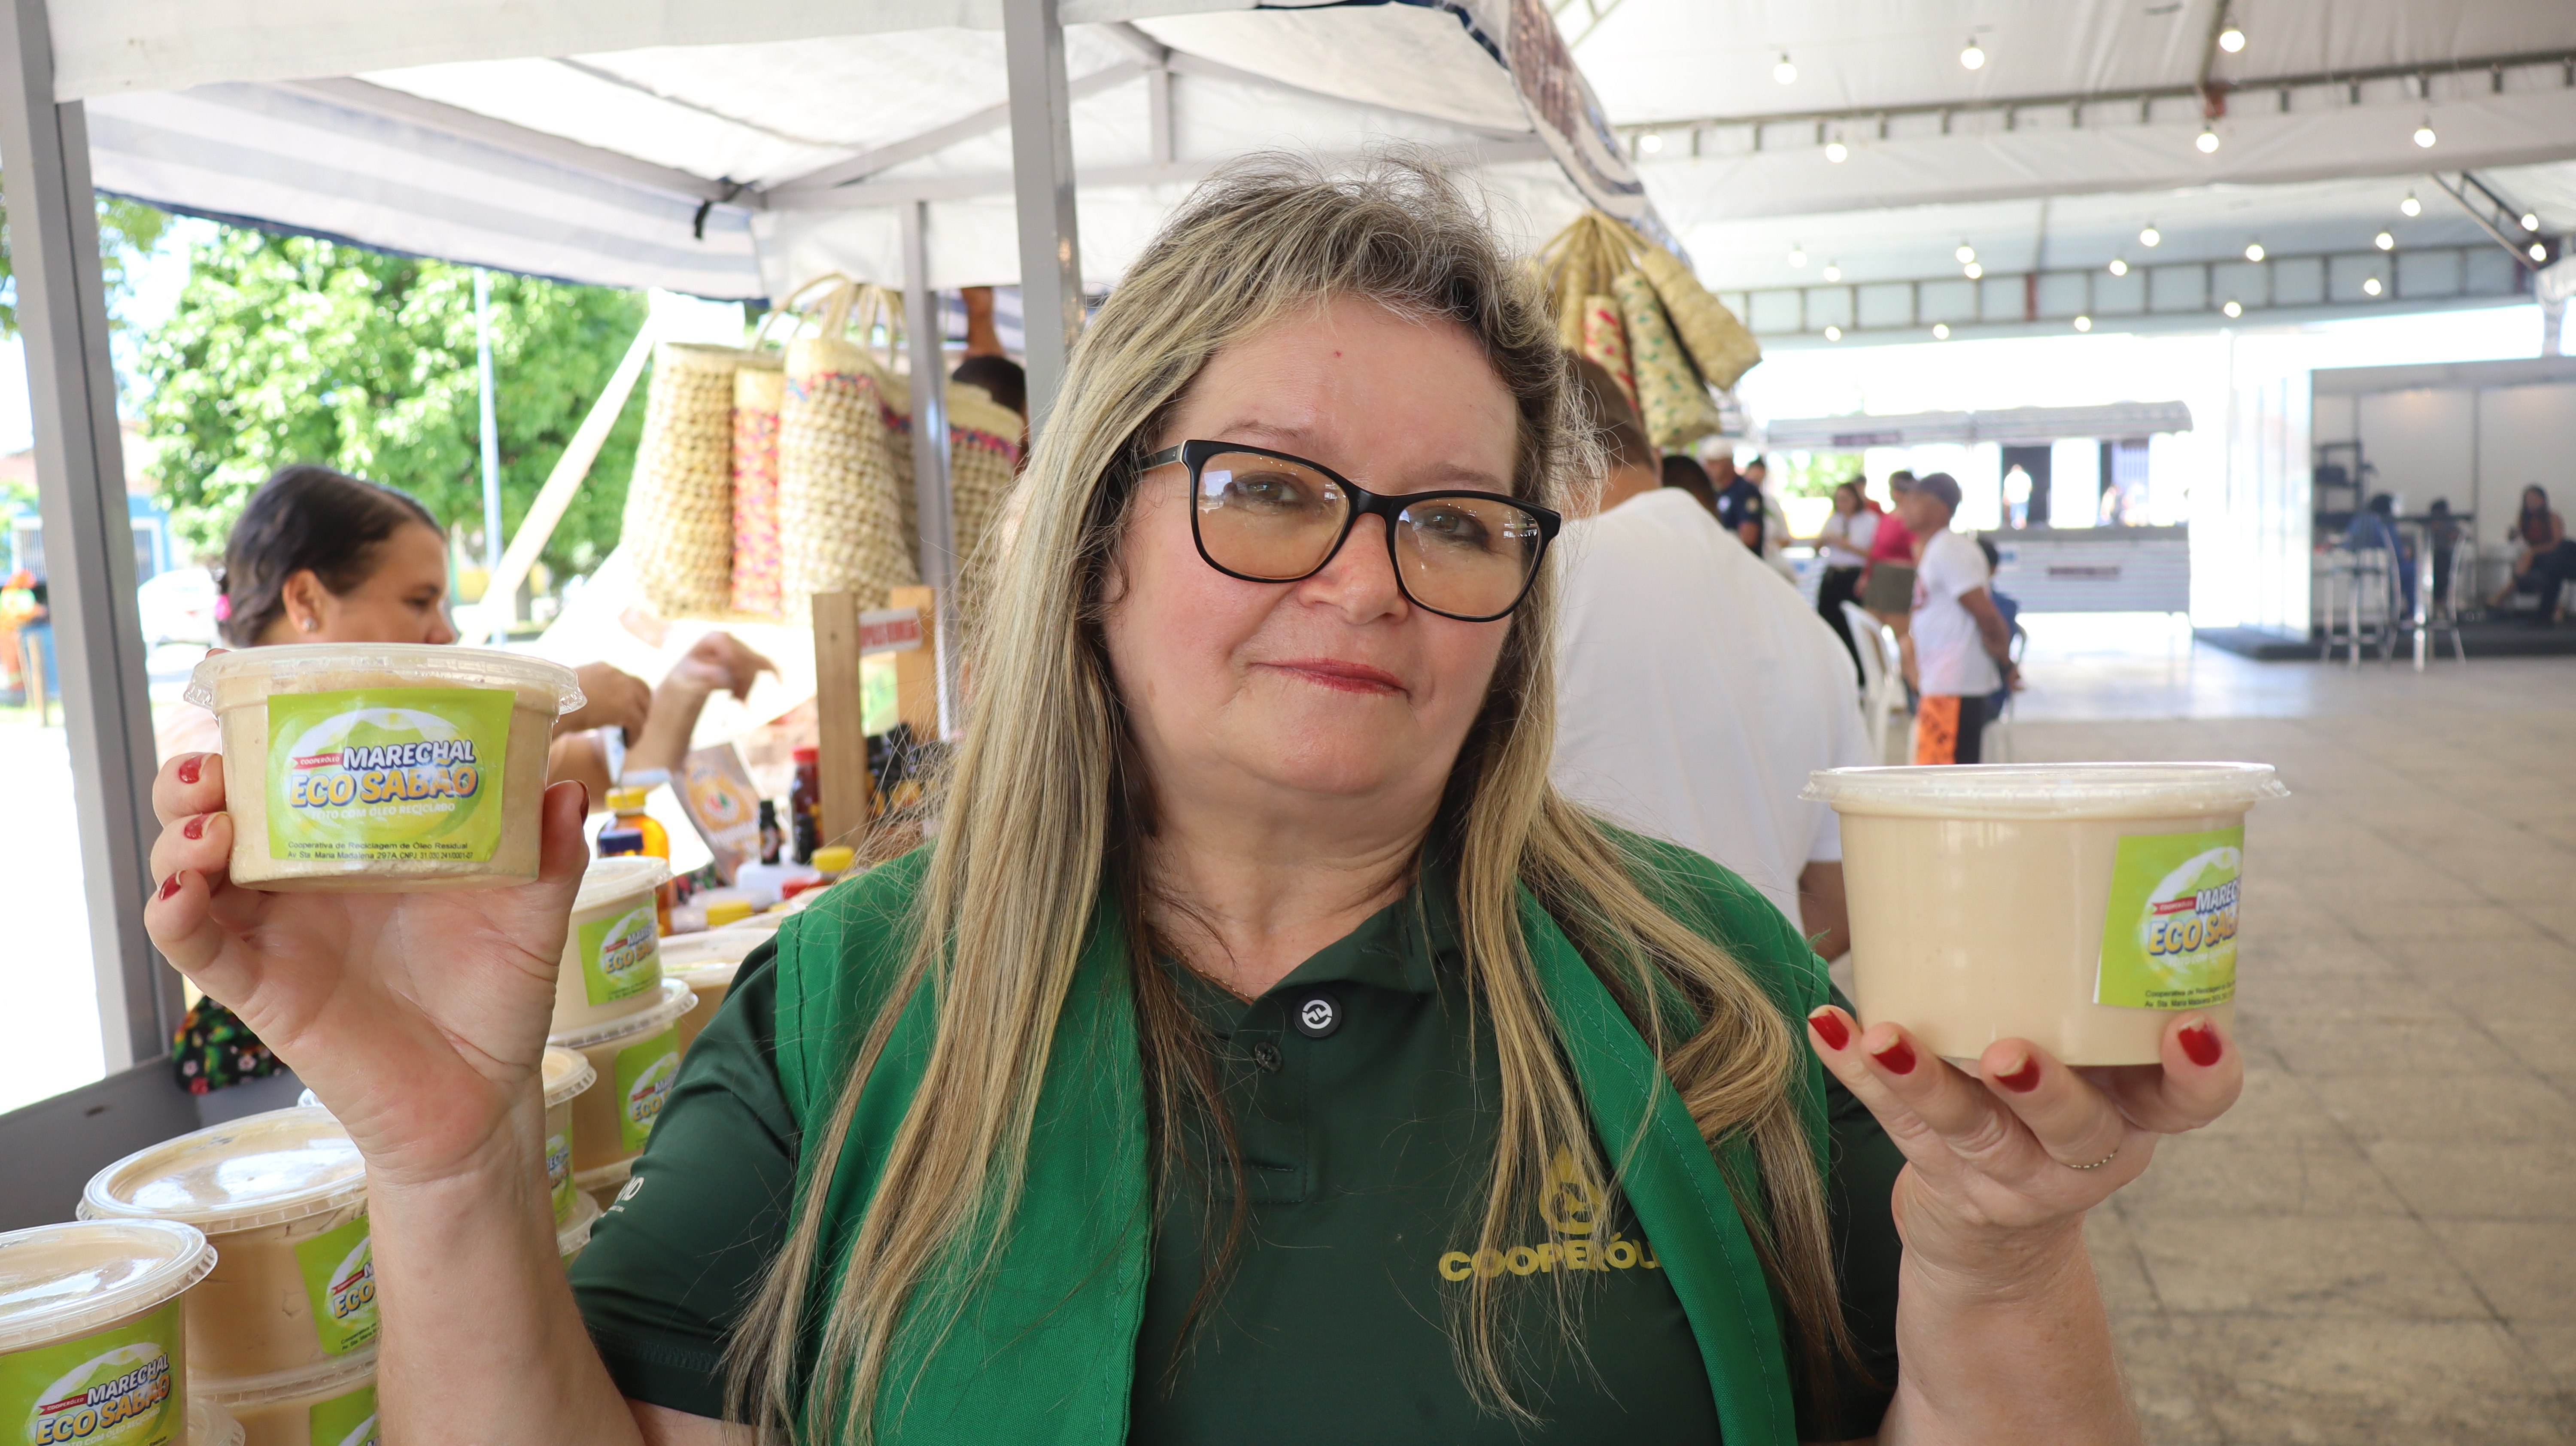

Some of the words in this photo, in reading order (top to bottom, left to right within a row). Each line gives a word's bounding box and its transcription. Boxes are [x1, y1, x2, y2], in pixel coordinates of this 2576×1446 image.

[343, 740, 476, 770] MARECHAL
[290, 773, 357, 808] ECO
[360, 757, 478, 804] SABÃO
[341, 808, 367, 818] COM
[369, 805, 397, 817] ÓLEO
[349, 841, 397, 850] Reciclagem
[2149, 917, 2203, 955] ECO
[605, 948, 634, 973] ECO
[633, 1095, 662, 1122] ECO
[333, 1279, 375, 1318] ECO
[86, 1352, 169, 1407] MARECHAL
[36, 1408, 98, 1446] ECO
[100, 1373, 170, 1428] SABÃO
